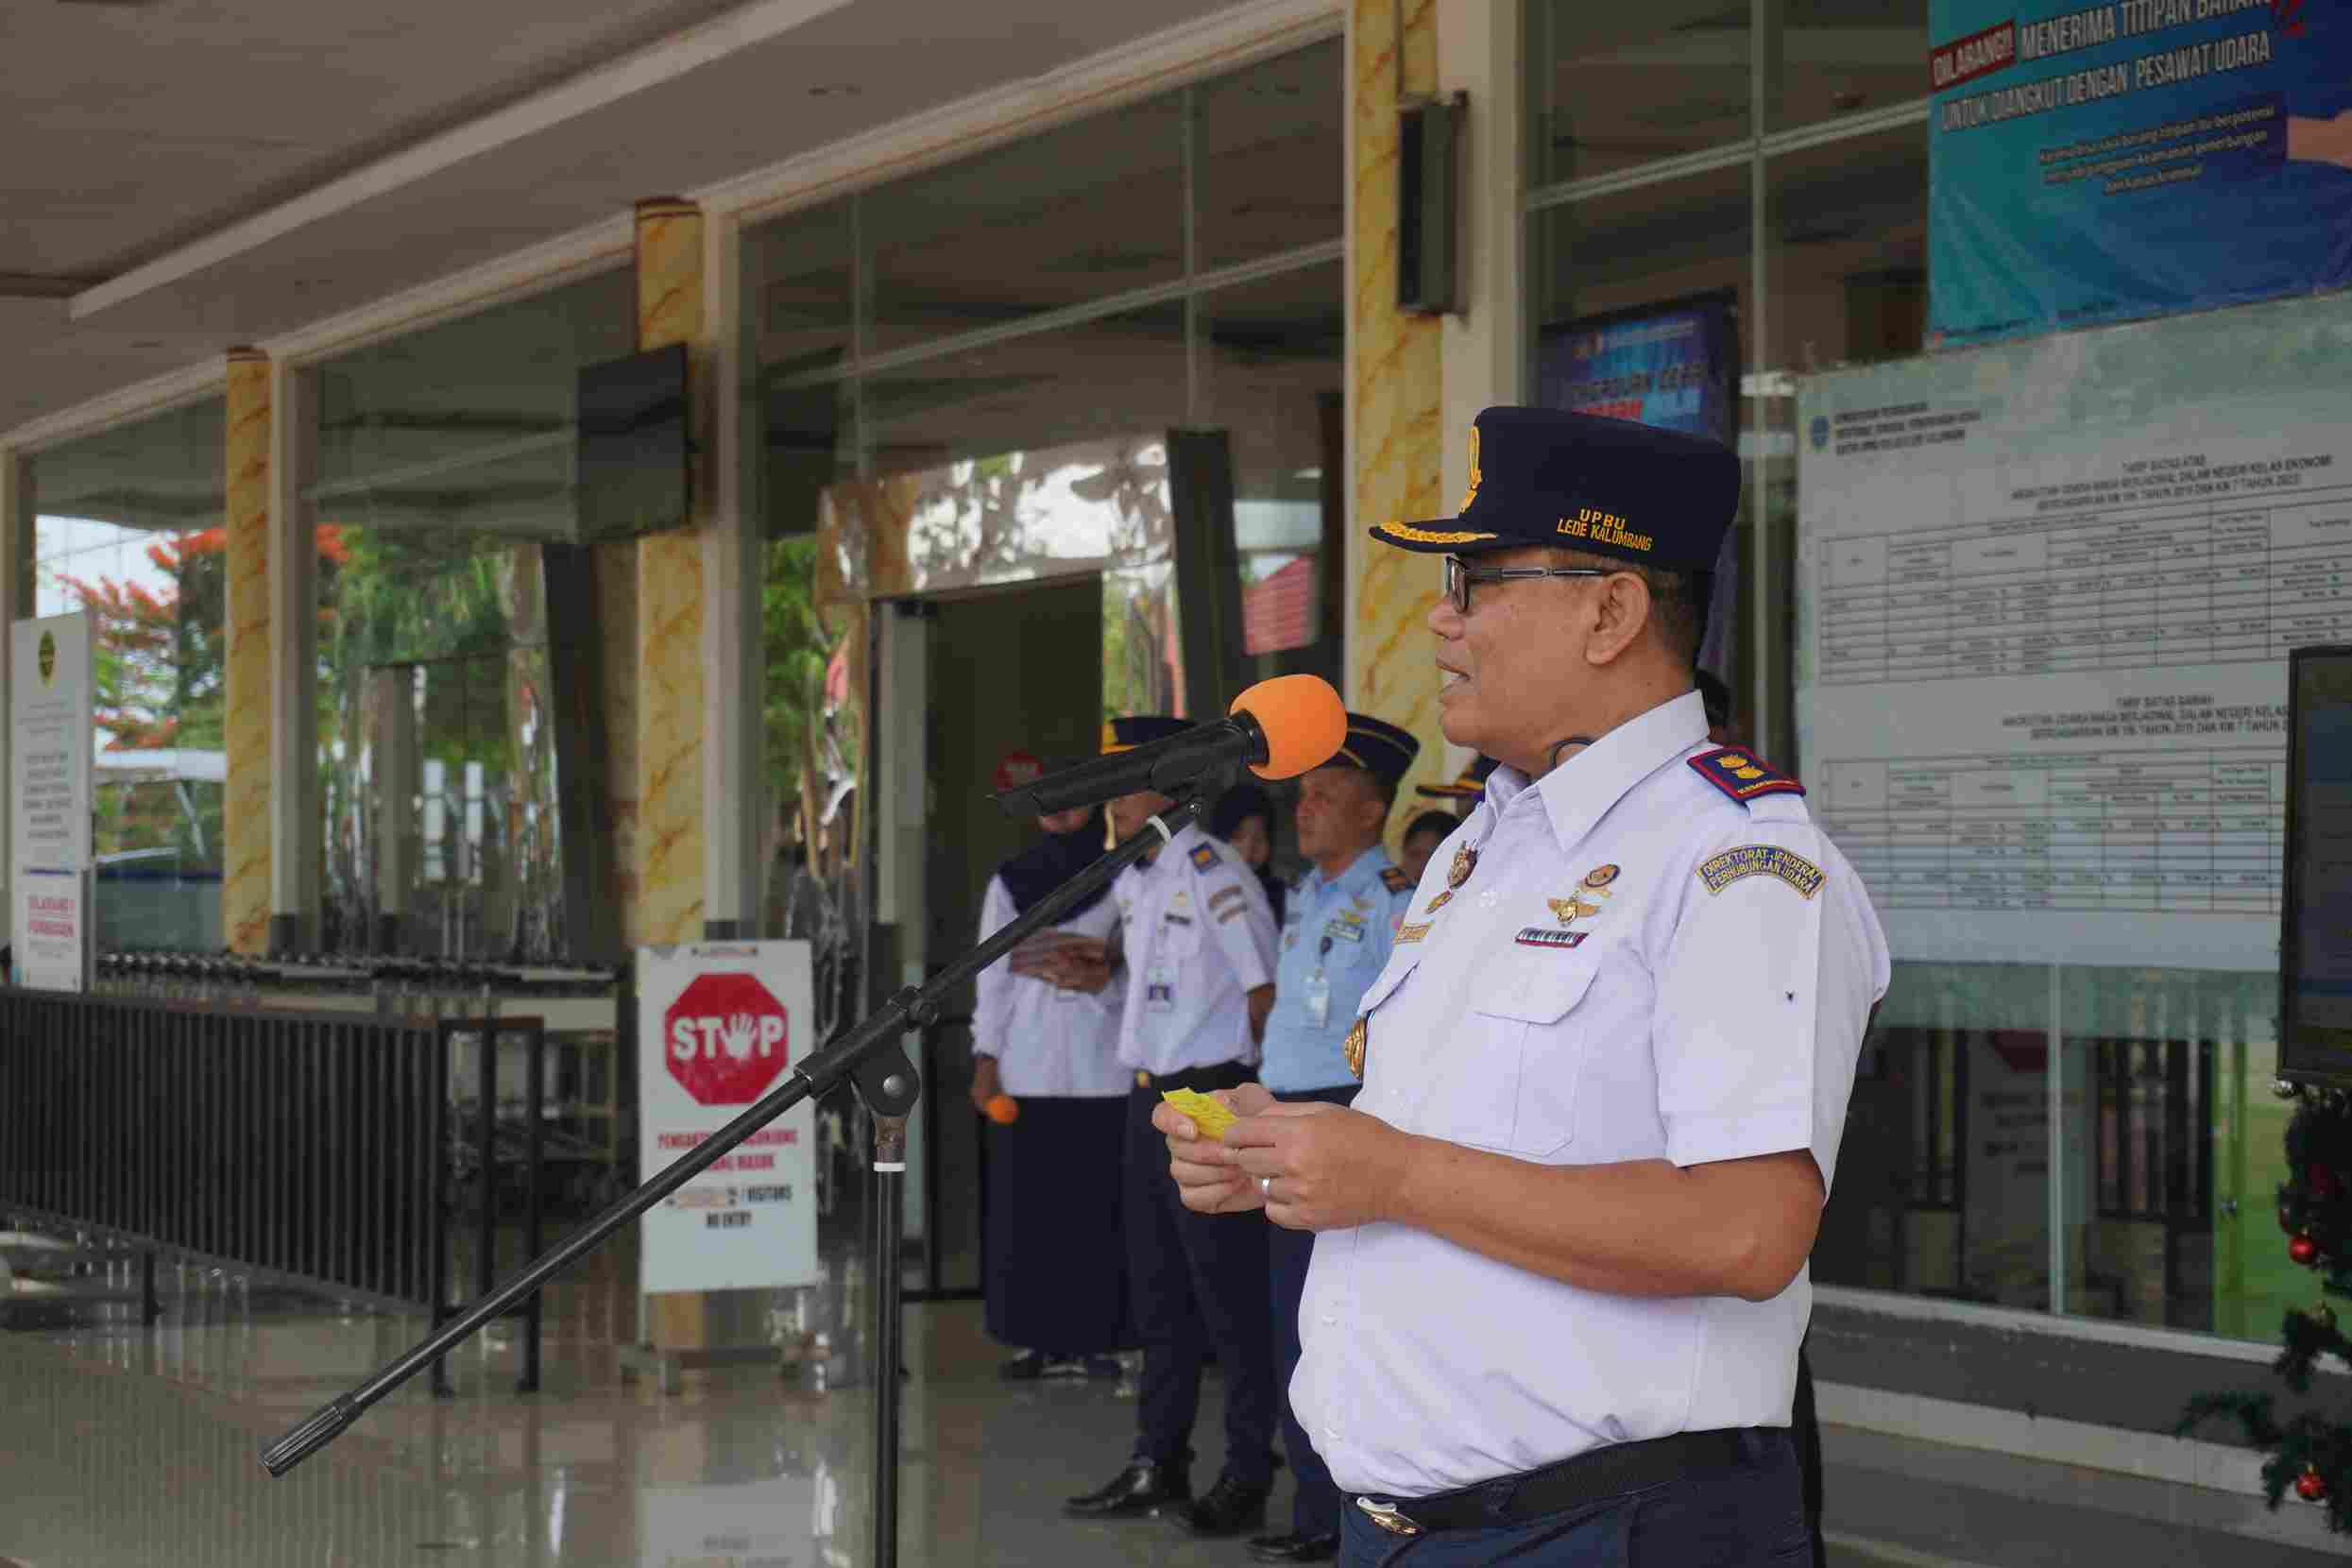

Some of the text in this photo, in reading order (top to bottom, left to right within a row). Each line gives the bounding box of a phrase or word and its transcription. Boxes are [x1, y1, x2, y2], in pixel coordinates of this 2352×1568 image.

[2021, 9, 2116, 59] MENERIMA
[2121, 0, 2192, 36] TITIPAN
[1942, 29, 2271, 130] UNTUK DIANGKUT DENGAN PESAWAT UDARA
[1557, 518, 1653, 552] LEDE KALUMBANG
[1579, 508, 1626, 530] UPBU
[1703, 848, 1822, 883] DIREKTORAT JENDERAL
[1782, 866, 1814, 893] UDARA
[747, 1183, 793, 1203] VISITORS
